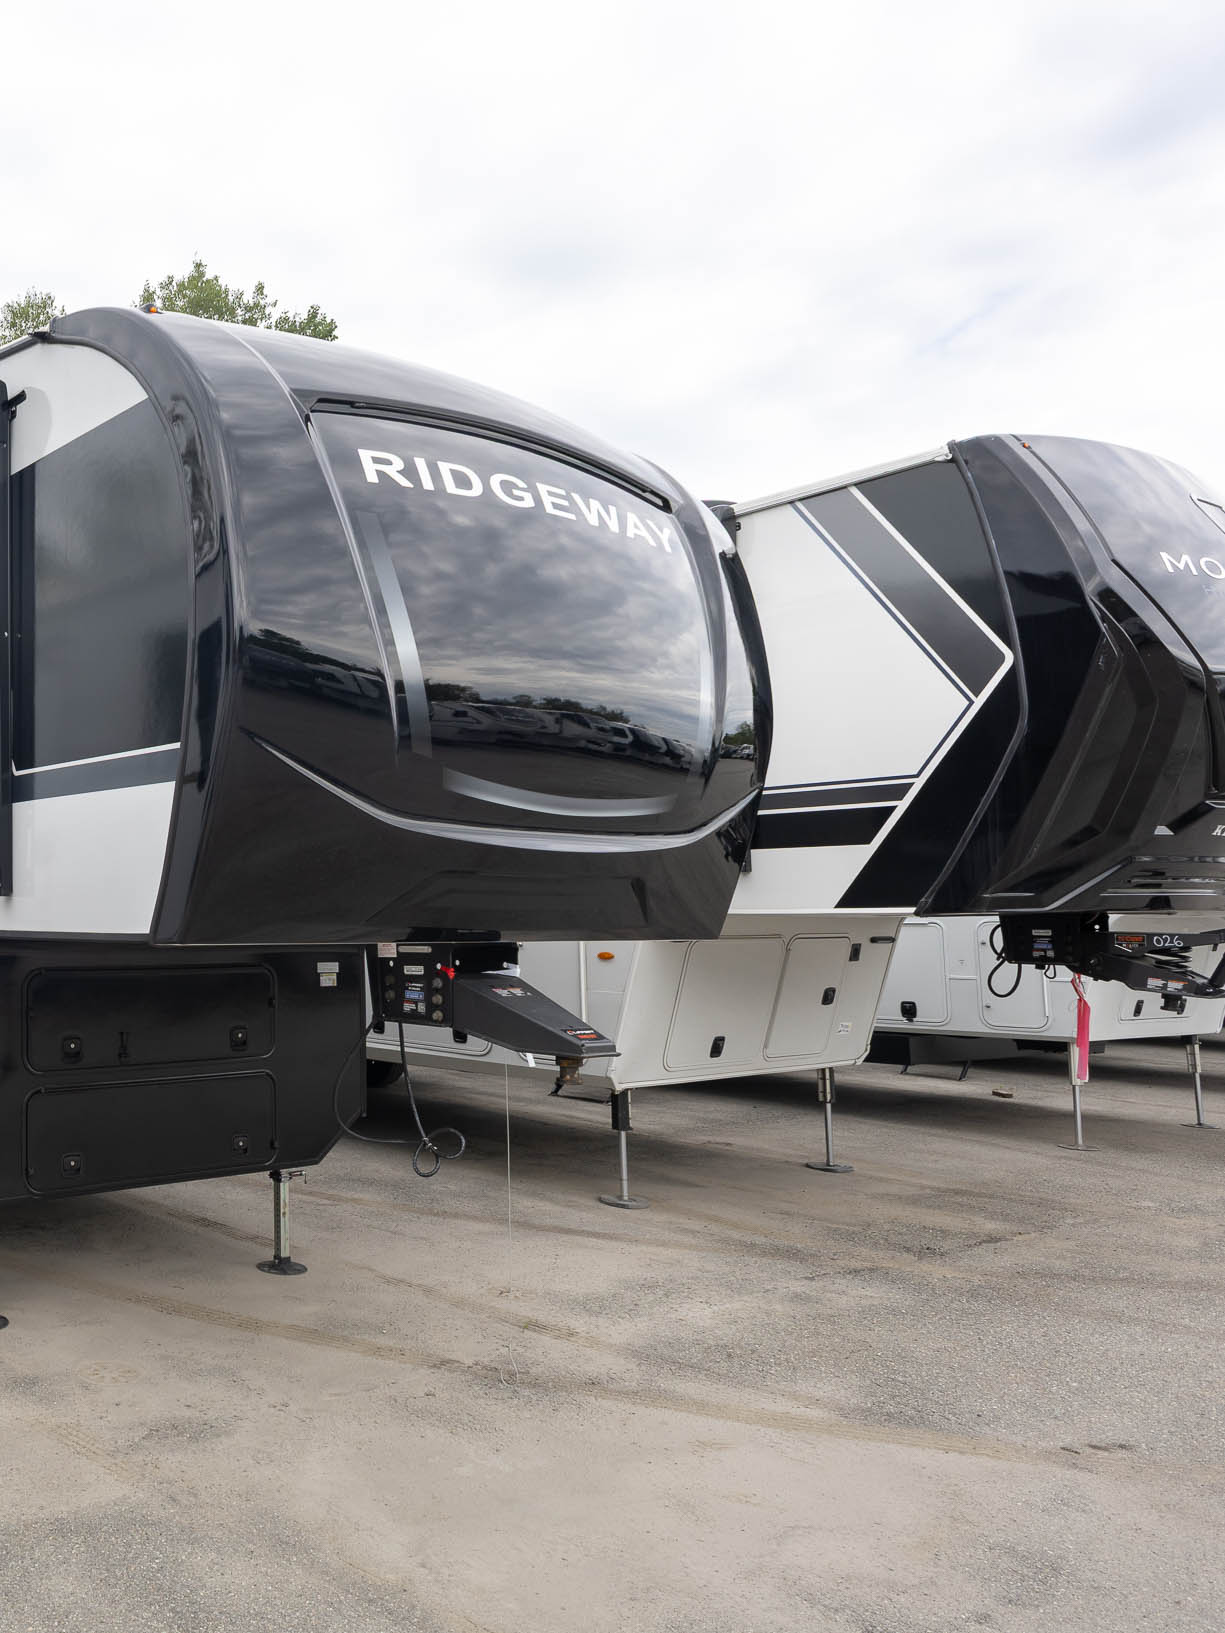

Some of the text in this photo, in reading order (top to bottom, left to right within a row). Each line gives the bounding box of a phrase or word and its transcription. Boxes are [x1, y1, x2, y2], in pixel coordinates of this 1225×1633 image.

[357, 448, 673, 554] RIDGEWAY
[1159, 551, 1225, 579] MO
[1153, 934, 1184, 948] 026
